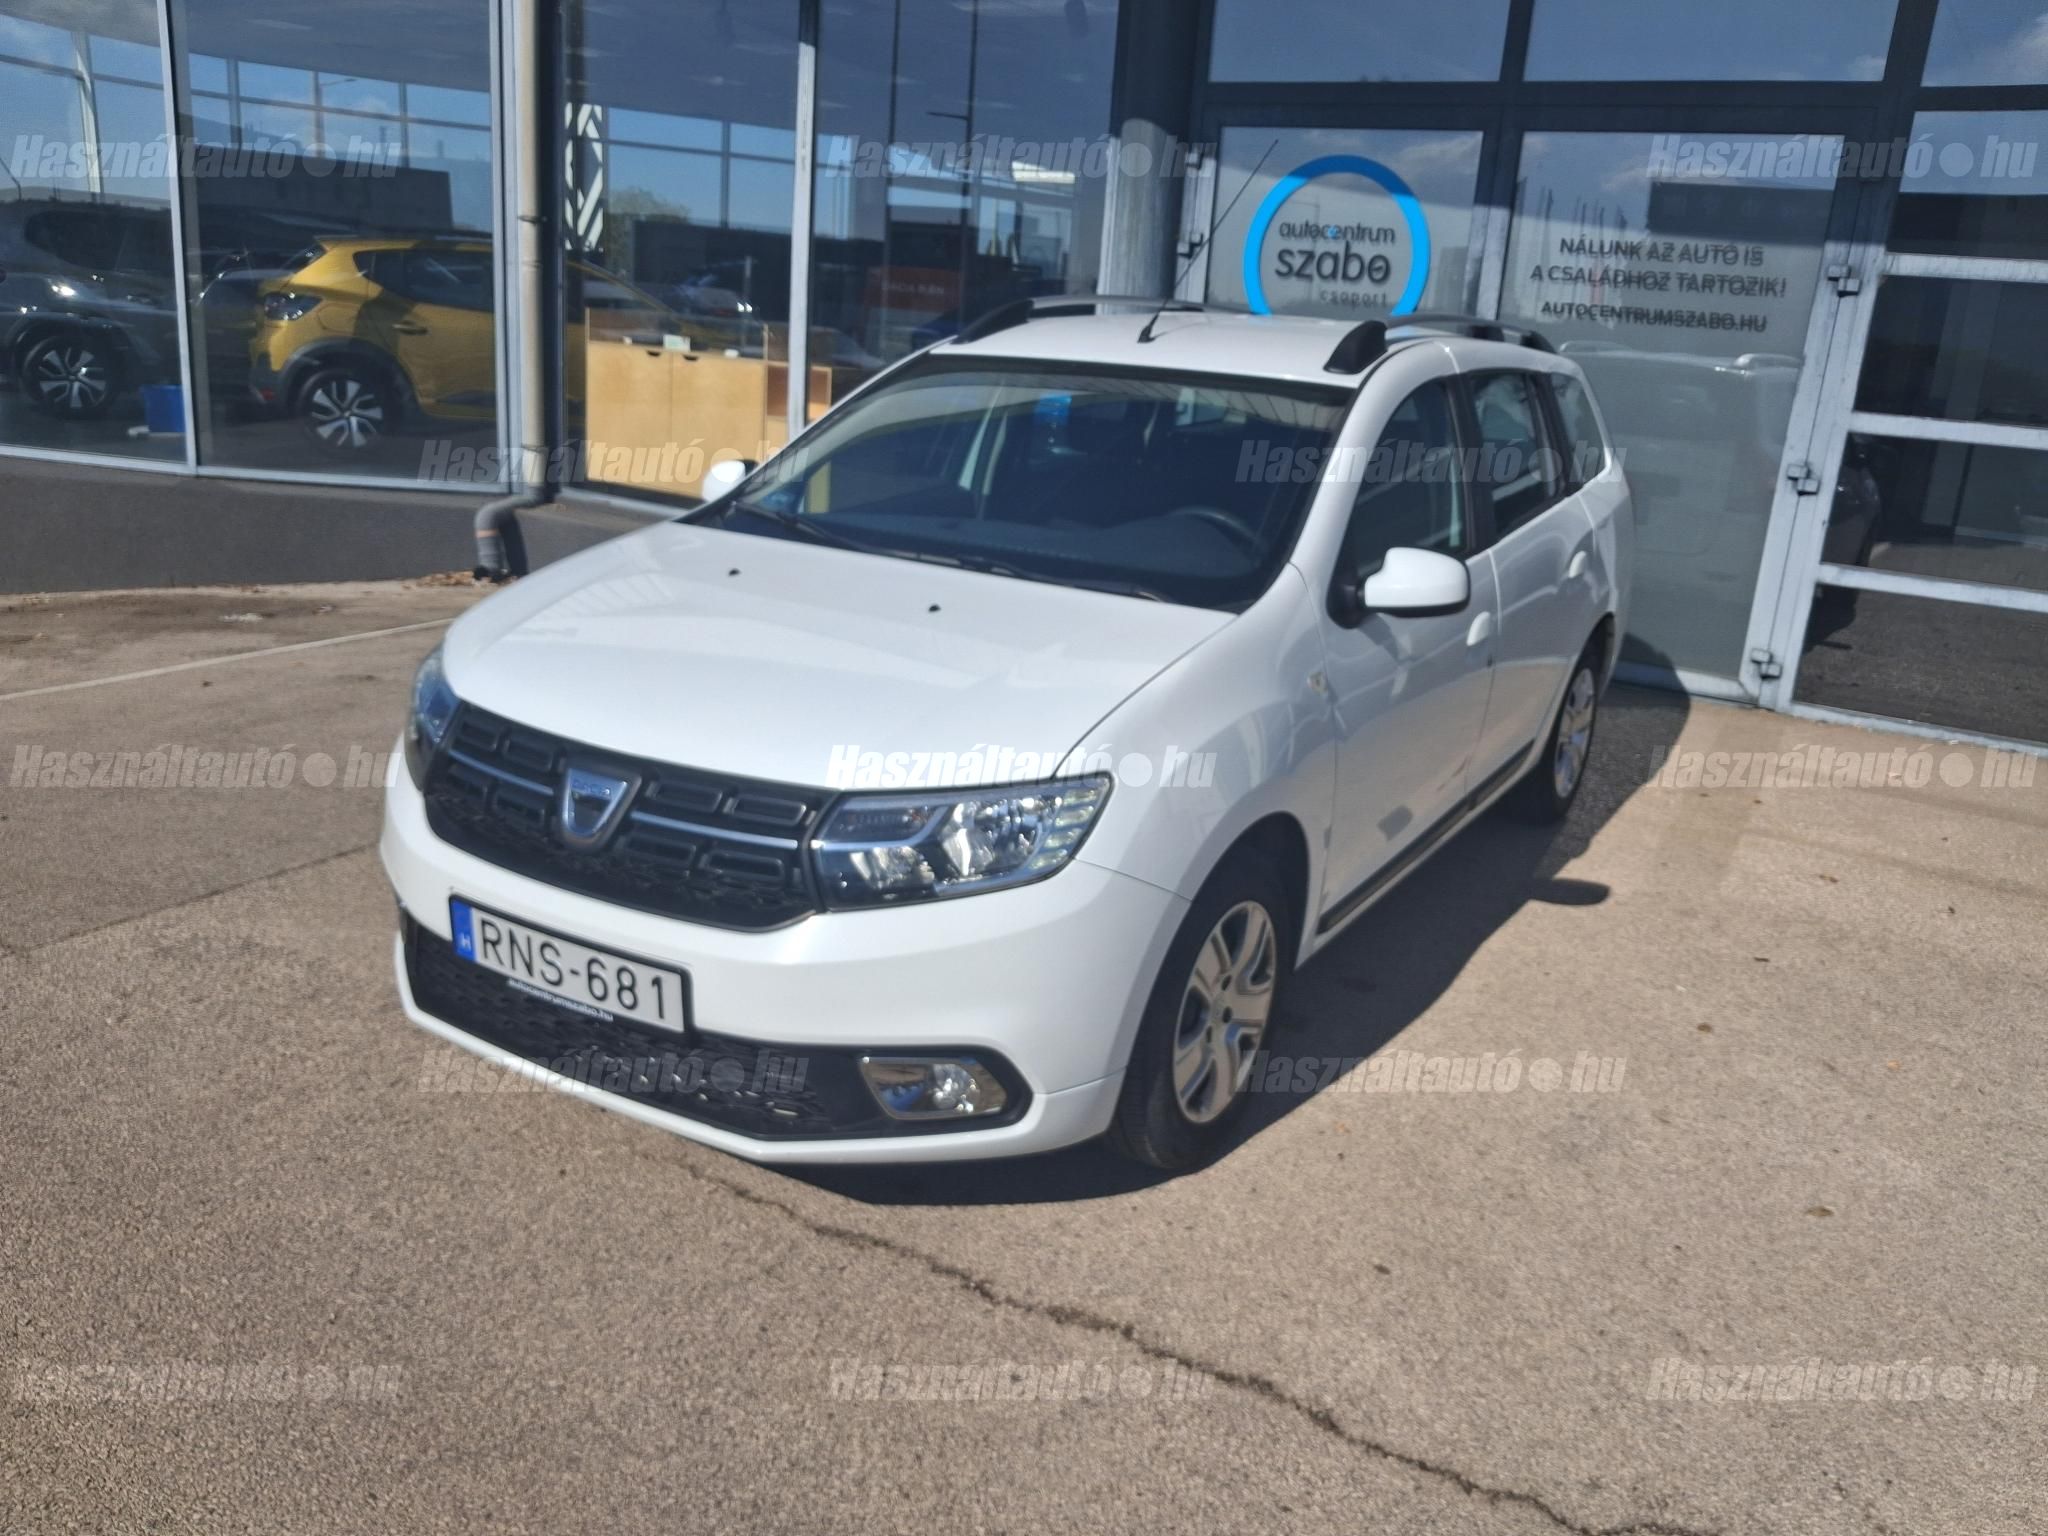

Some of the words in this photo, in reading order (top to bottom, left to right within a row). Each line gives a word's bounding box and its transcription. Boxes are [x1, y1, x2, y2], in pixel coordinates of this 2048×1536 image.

[1279, 219, 1396, 243] autocentrum
[1560, 233, 1642, 260] NÁLUNK
[1647, 242, 1675, 262] AZ
[1744, 245, 1765, 267] IS
[1530, 264, 1544, 281] A
[1548, 264, 1672, 292] CSALÁDHOZ
[1675, 271, 1787, 298] TARTOZIK!
[1319, 289, 1388, 309] csoport
[480, 917, 665, 1020] RNS-681
